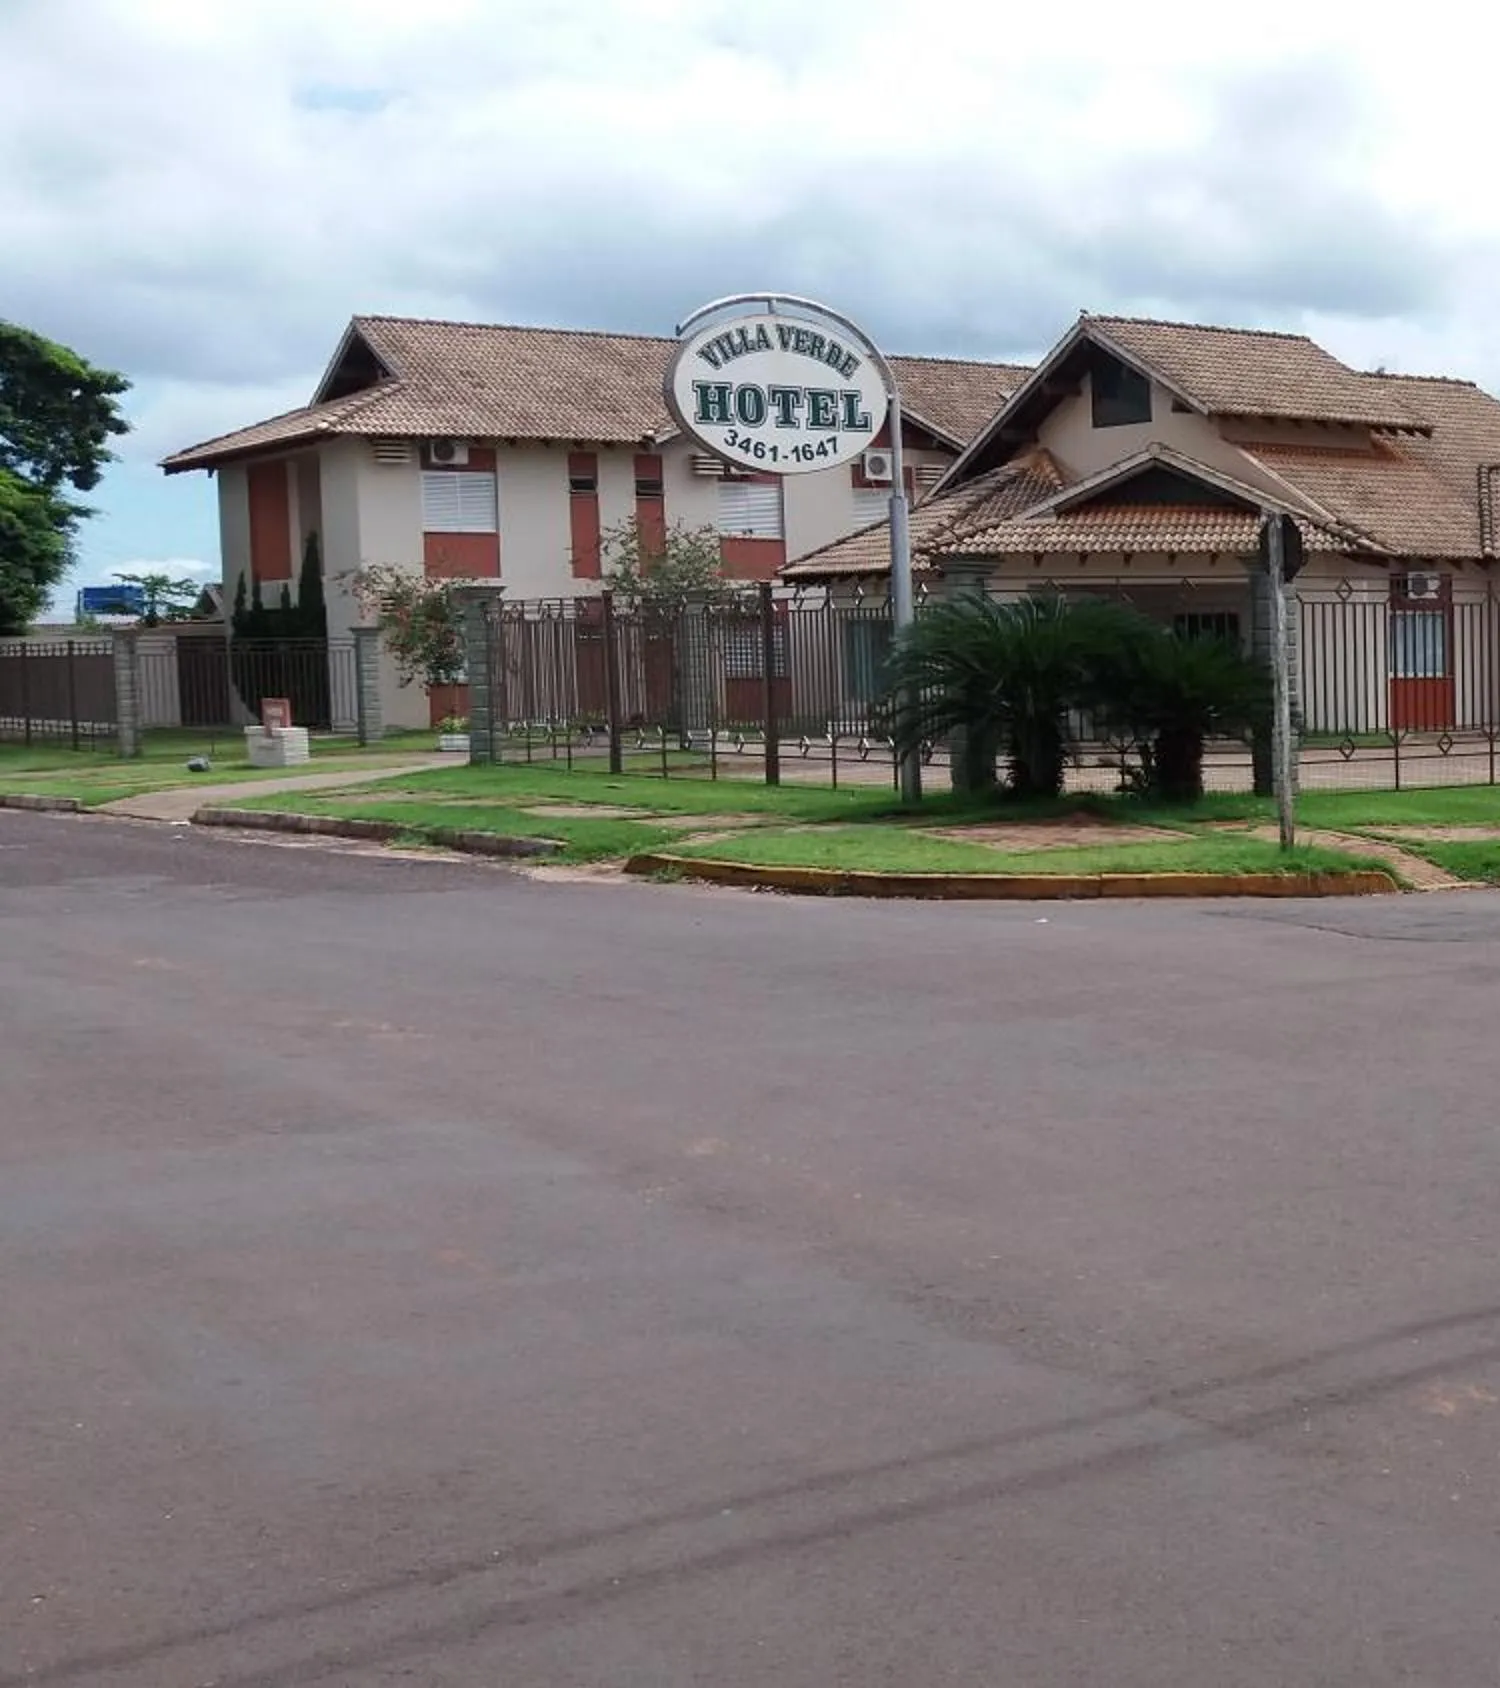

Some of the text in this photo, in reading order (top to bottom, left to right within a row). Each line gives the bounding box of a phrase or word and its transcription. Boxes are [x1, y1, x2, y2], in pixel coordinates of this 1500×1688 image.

[697, 324, 862, 379] VILLA VERDE
[692, 380, 873, 432] HOTEL
[724, 429, 839, 462] 3461-1647
